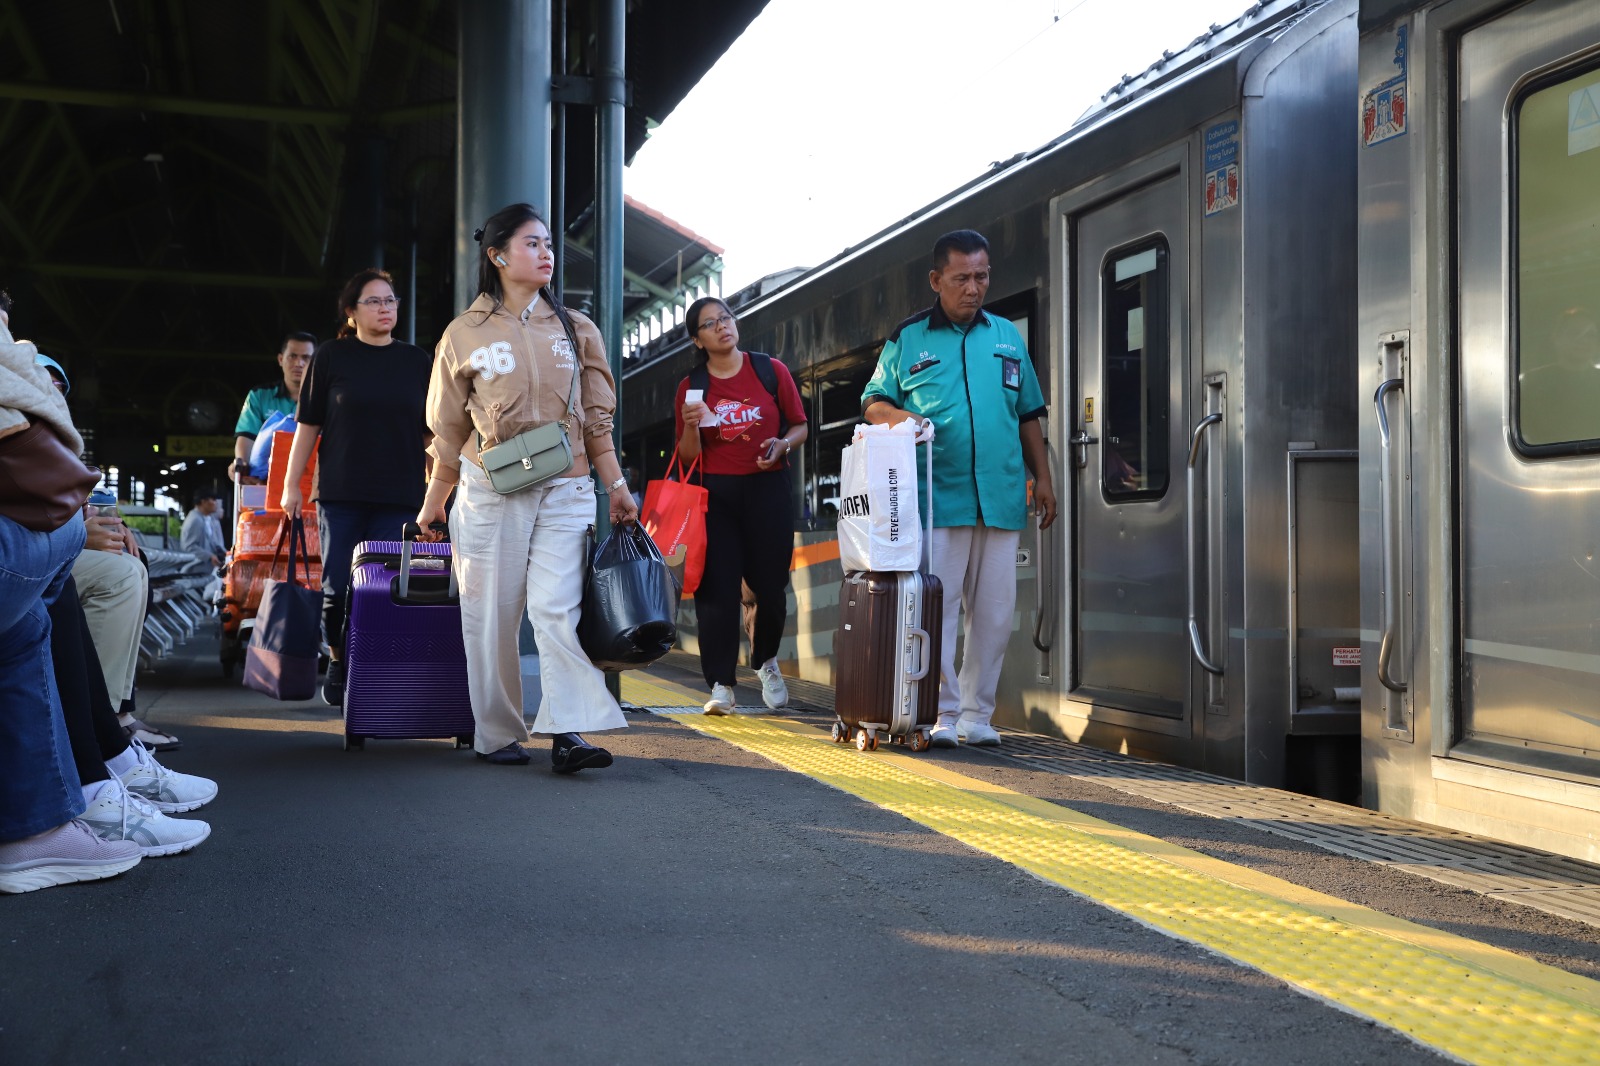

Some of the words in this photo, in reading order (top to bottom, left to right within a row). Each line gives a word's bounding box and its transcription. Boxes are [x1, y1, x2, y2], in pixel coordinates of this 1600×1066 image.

[1208, 124, 1235, 141] Dahulukan
[1208, 151, 1221, 162] Yang
[1221, 146, 1235, 158] Turun
[919, 350, 929, 359] 59
[995, 343, 1017, 351] PORTER
[470, 341, 515, 380] 96
[716, 402, 740, 412] OKKY
[716, 406, 763, 426] KLIK
[888, 468, 899, 542] STEVEMADDEN.COM
